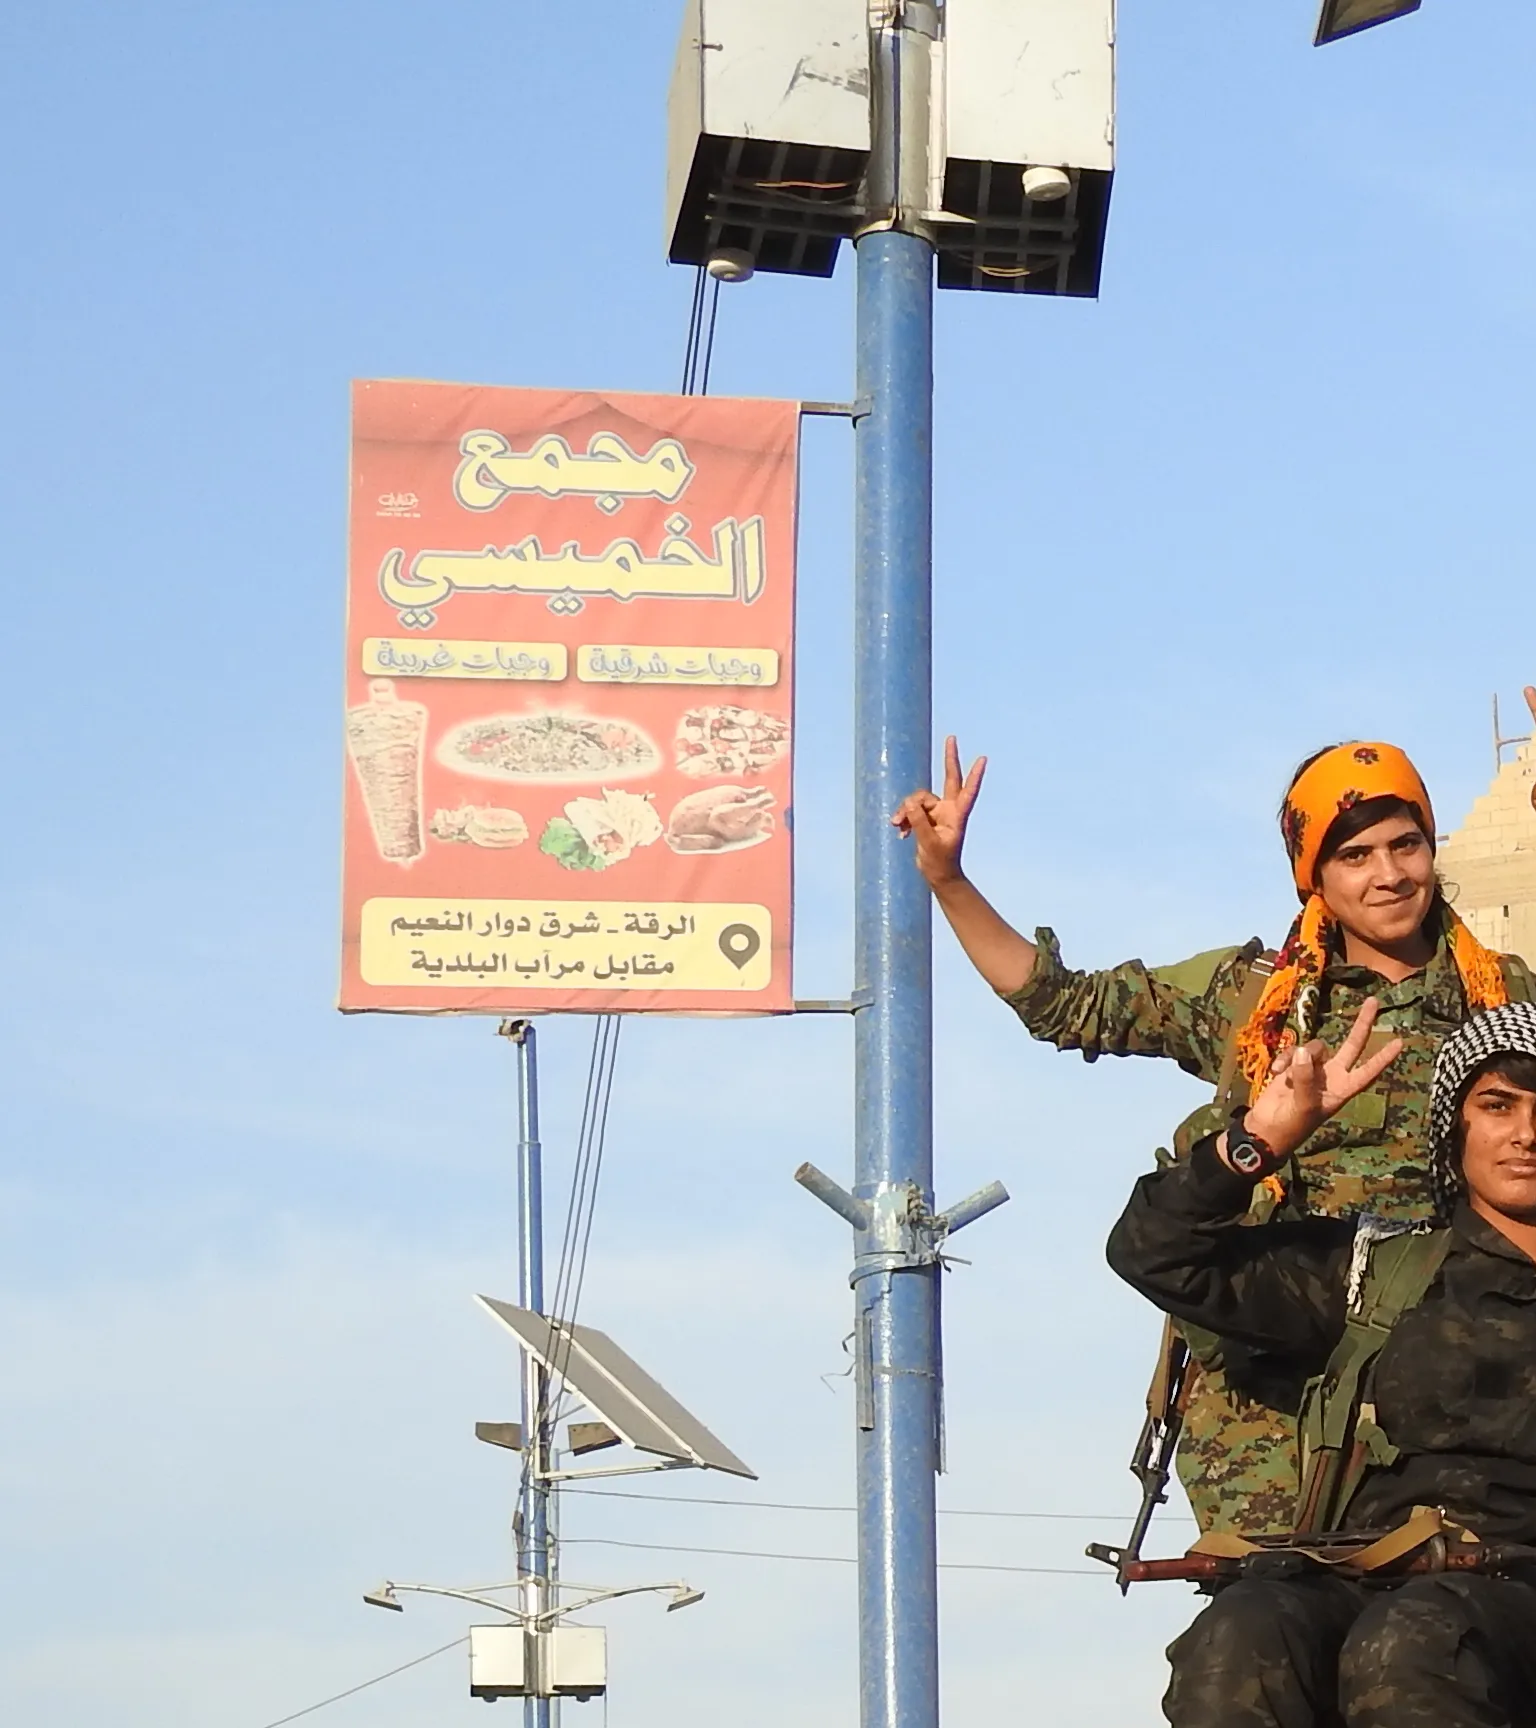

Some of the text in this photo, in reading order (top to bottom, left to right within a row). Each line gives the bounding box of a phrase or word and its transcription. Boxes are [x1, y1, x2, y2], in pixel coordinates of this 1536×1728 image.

[454, 428, 695, 514] مجمع
[378, 514, 765, 629] الخميسي
[376, 640, 551, 676] وجبات غربية
[588, 647, 764, 682] وجبات شرقية
[391, 910, 473, 937] النعيم
[477, 912, 531, 937] دوار
[539, 911, 601, 939] شرق
[624, 912, 696, 940] الرقة
[411, 949, 674, 981] مقابل مرآب البلدية
